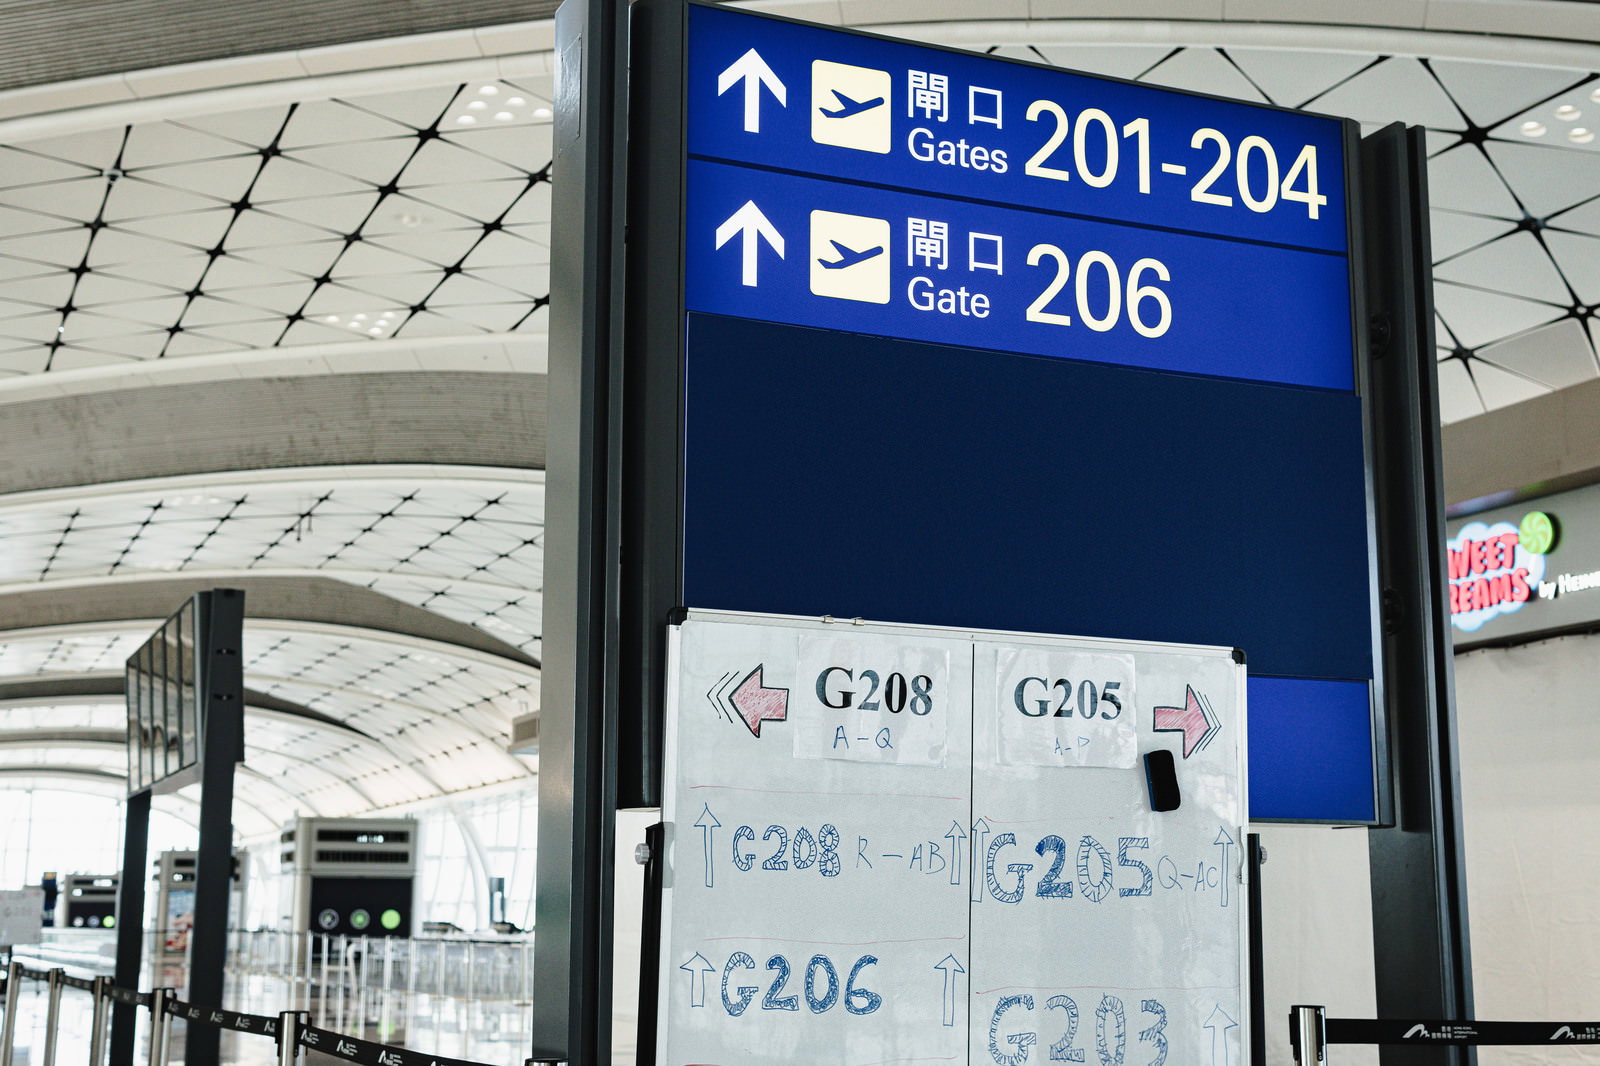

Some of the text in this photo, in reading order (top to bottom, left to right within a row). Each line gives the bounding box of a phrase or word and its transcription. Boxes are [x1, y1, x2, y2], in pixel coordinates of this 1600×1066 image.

[907, 69, 1003, 130] 閘口
[907, 99, 1327, 220] Gates 201-204
[907, 217, 1003, 276] 閘口
[907, 243, 1173, 339] Gate 206
[815, 666, 933, 717] G208
[1013, 676, 1122, 720] G205
[732, 823, 841, 877] G208
[986, 833, 1153, 905] G205
[721, 951, 883, 1017] G206
[988, 992, 1169, 1066] G203
